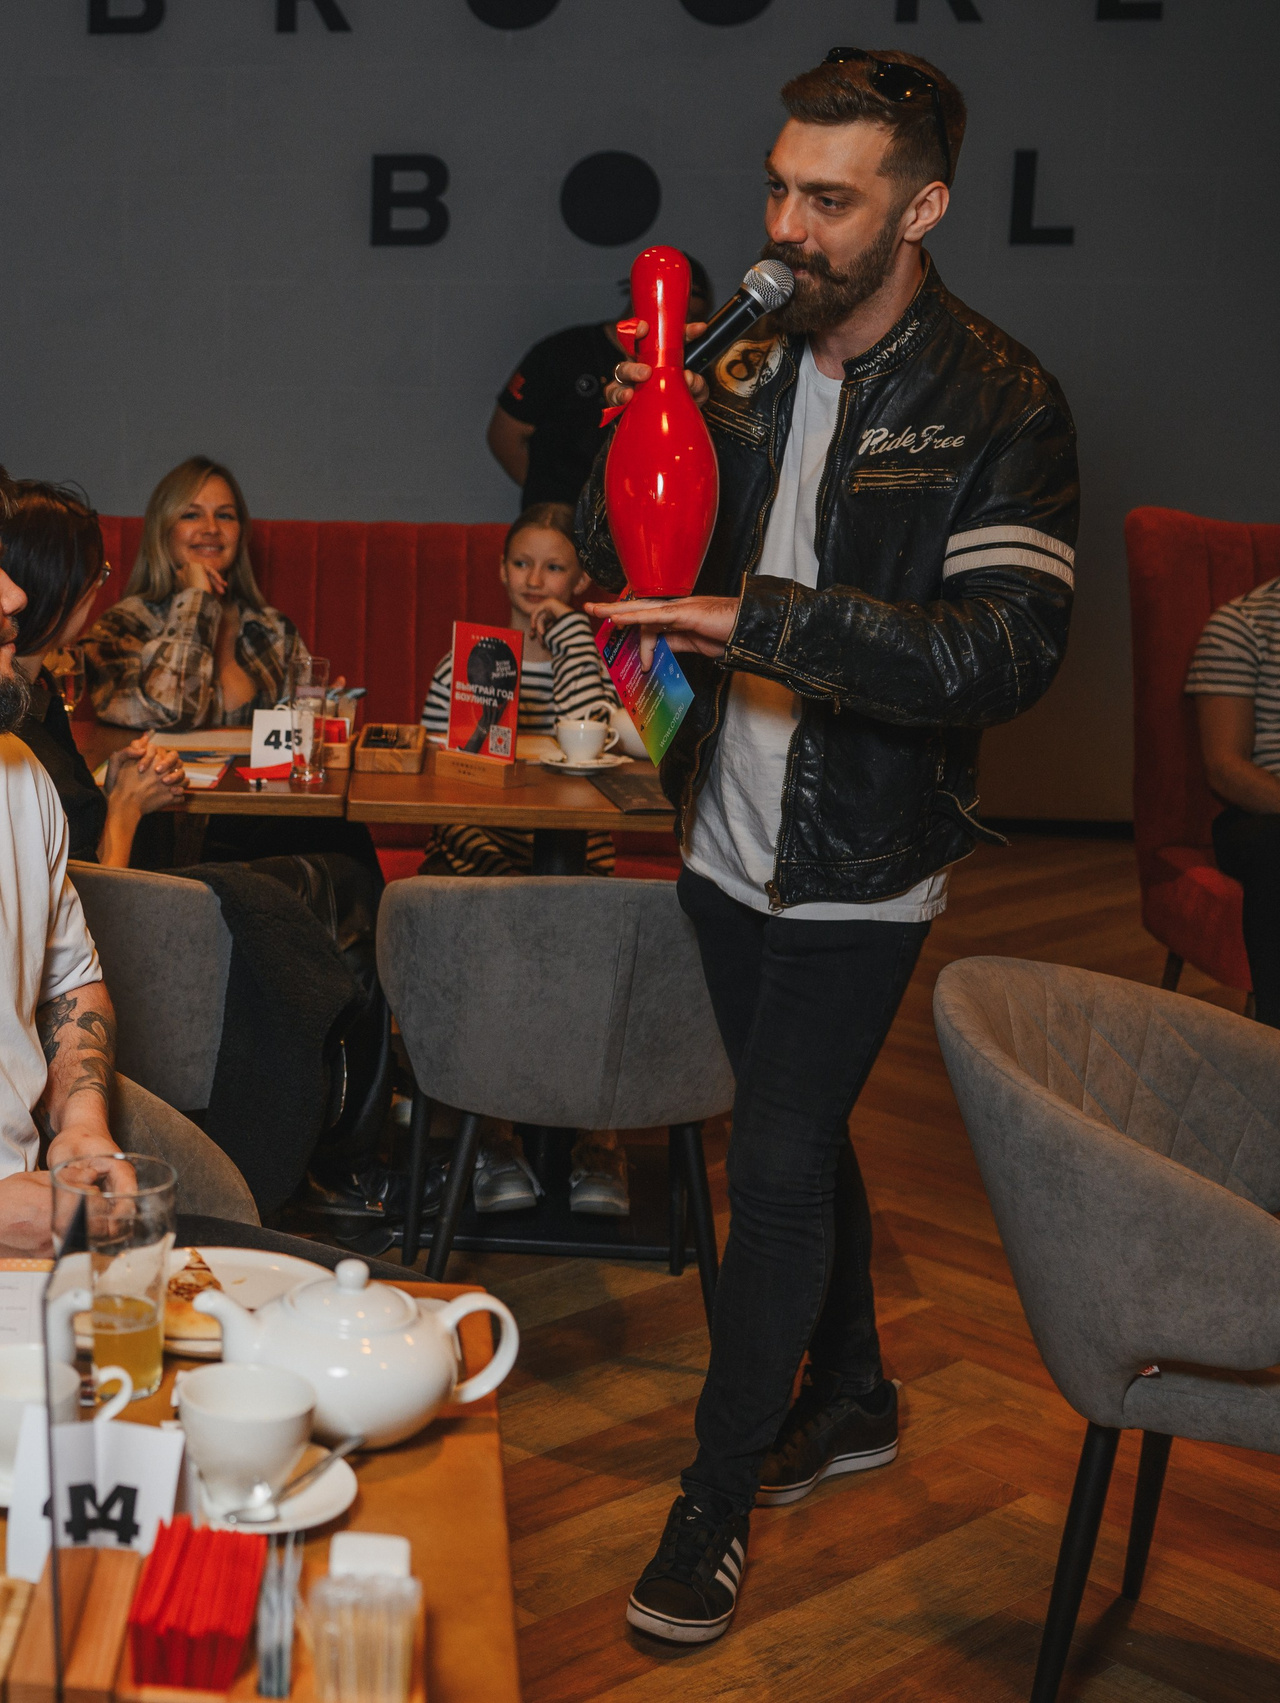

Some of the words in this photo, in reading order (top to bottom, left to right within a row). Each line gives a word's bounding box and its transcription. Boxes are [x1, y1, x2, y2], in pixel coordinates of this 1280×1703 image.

[369, 149, 1075, 248] BOL
[858, 426, 916, 455] Ride
[909, 425, 965, 454] Free
[454, 691, 499, 708] БОУЛИНГА
[455, 680, 496, 697] ВЫИГРАЙ
[496, 688, 515, 702] ГОД
[263, 728, 303, 751] 45
